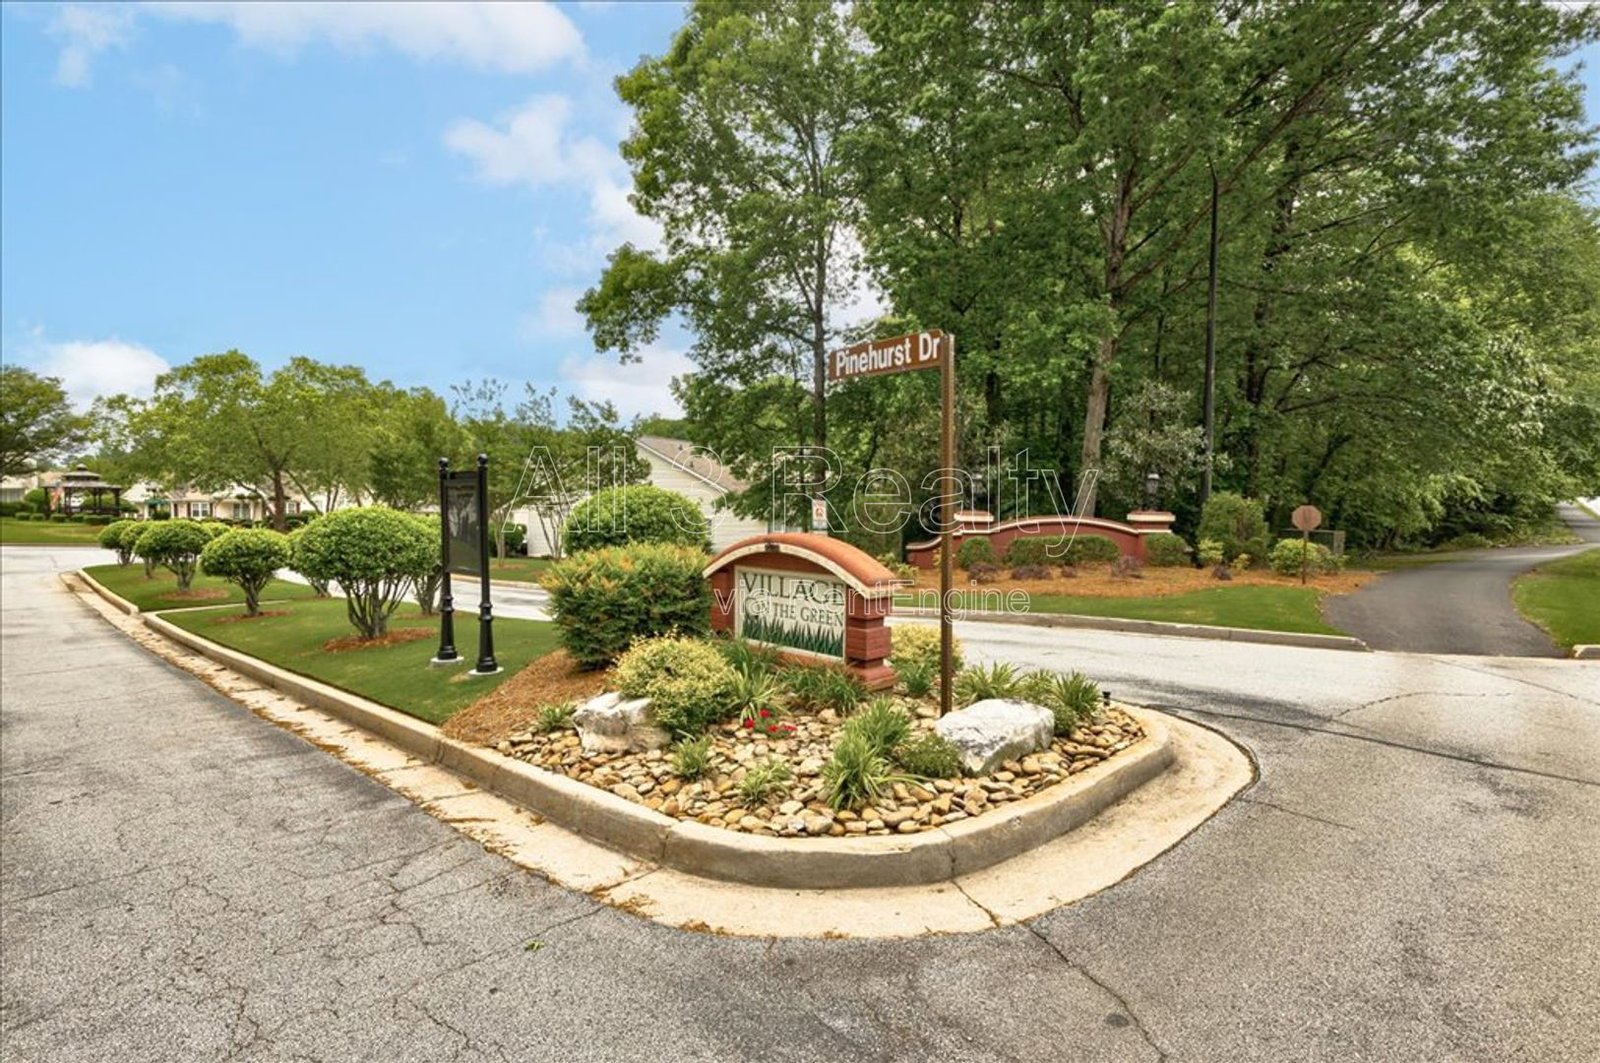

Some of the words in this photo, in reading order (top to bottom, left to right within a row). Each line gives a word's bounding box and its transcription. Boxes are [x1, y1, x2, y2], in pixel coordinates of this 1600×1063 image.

[835, 337, 912, 377] Pinehurst
[918, 332, 941, 361] Dr
[741, 572, 844, 606] VILLAGE
[772, 602, 796, 620] THE
[800, 606, 844, 627] GREEN
